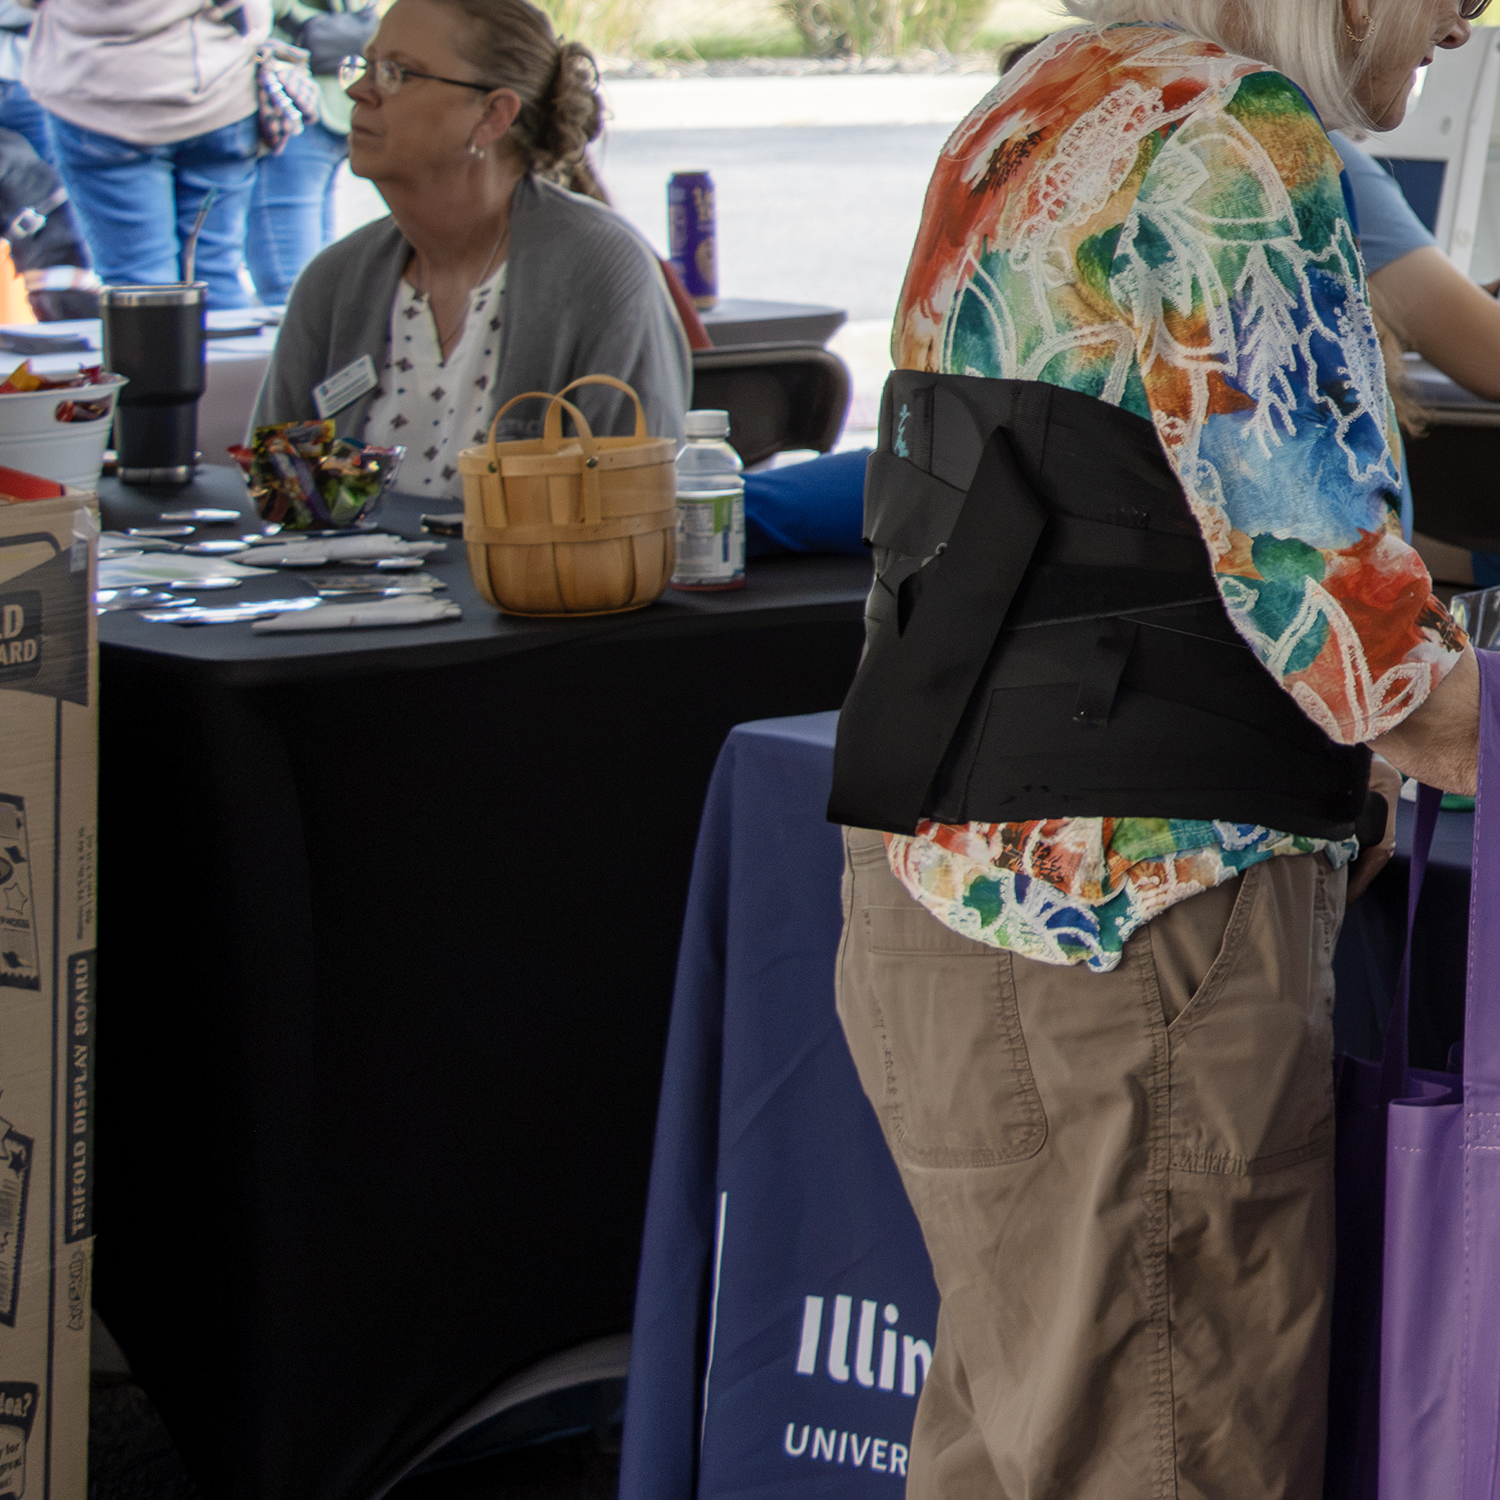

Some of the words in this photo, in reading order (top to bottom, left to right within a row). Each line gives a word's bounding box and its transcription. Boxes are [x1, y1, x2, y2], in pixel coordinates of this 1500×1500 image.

[74, 957, 90, 1038] BOARD
[72, 1044, 89, 1135] DISPLAY
[71, 1140, 88, 1237] TRIFOLD
[784, 1421, 909, 1478] UNIVER
